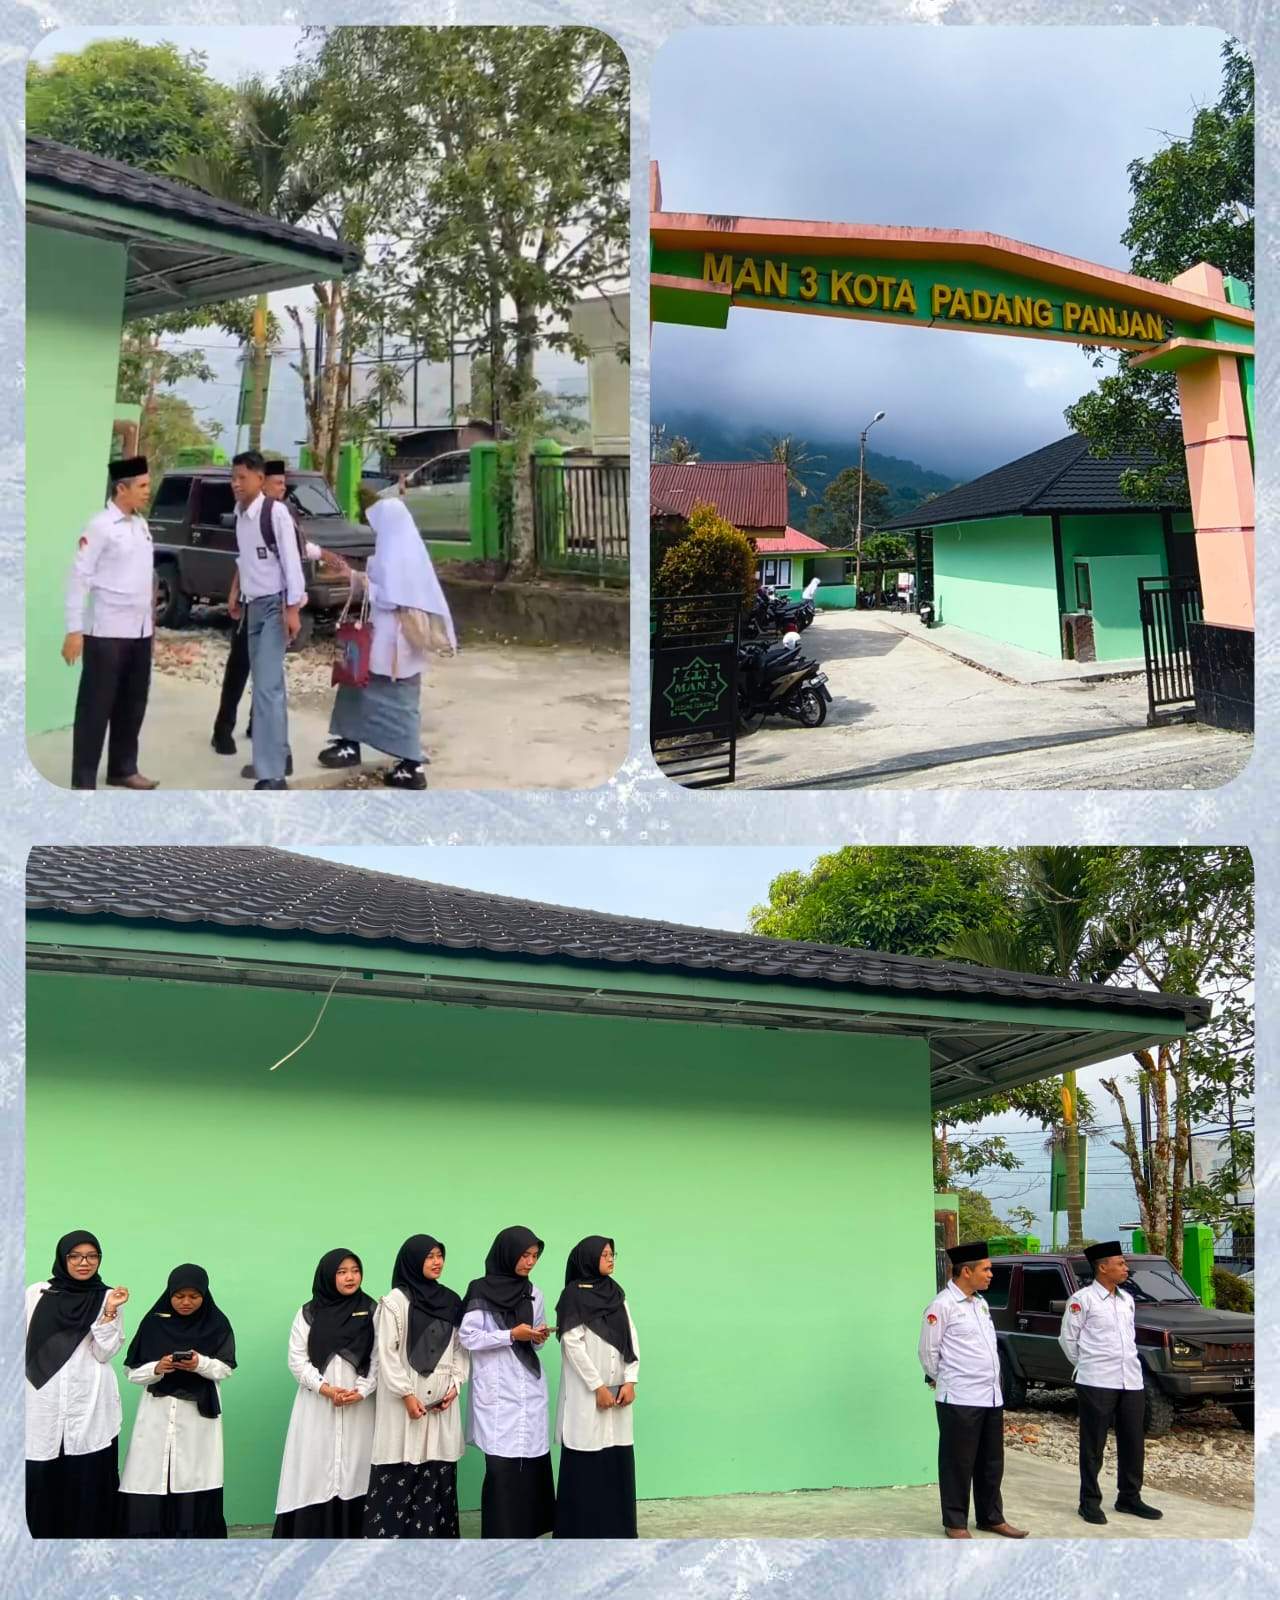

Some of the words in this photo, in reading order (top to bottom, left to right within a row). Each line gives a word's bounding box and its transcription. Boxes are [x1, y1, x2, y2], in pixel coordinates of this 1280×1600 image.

[702, 252, 788, 298] MAN
[799, 266, 819, 300] 3
[830, 269, 917, 313] KOTA
[931, 283, 1054, 328] PADANG
[1063, 301, 1174, 340] PANJAN
[674, 680, 706, 694] MAN
[710, 680, 718, 689] 3
